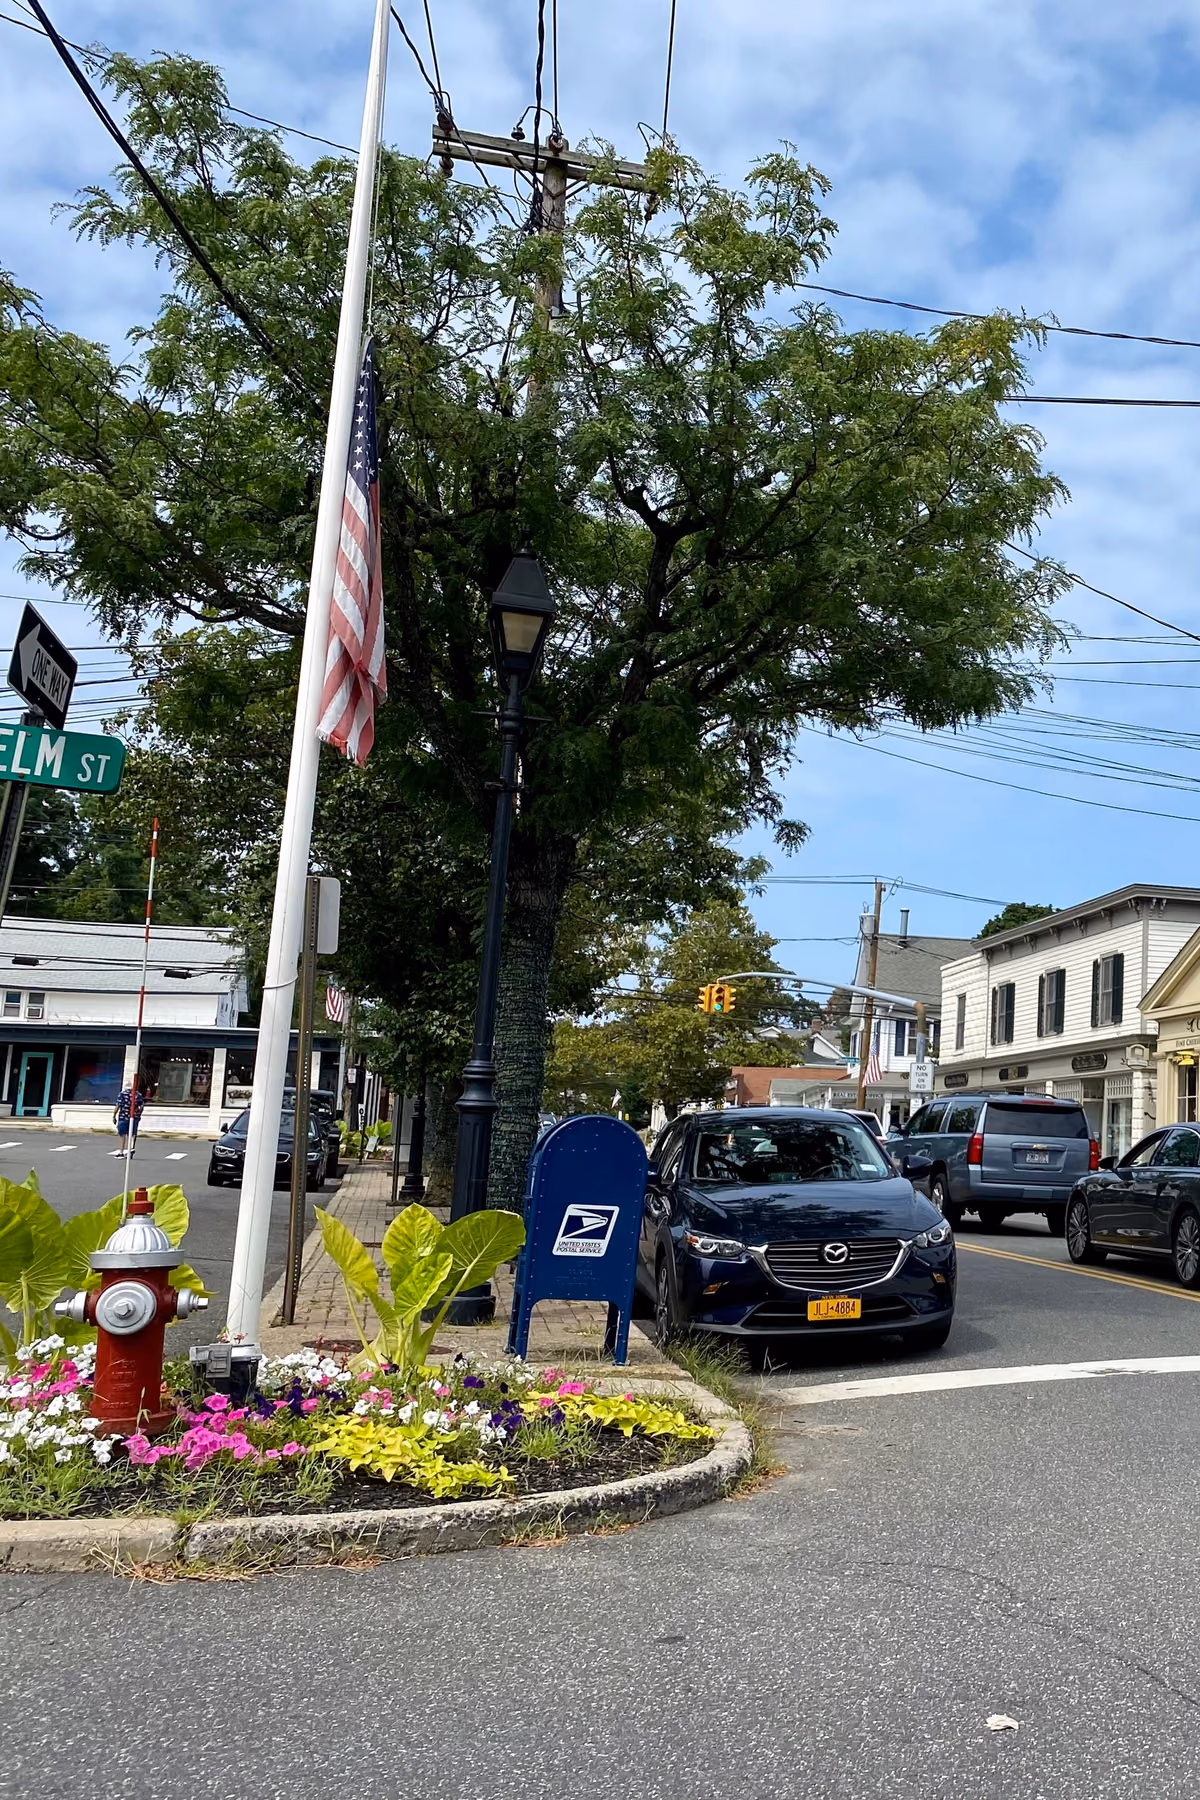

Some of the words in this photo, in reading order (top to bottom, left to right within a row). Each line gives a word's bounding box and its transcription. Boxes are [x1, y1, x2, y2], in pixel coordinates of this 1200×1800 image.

[32, 648, 51, 688] ONE
[50, 667, 68, 705] WAY
[77, 753, 111, 783] ST
